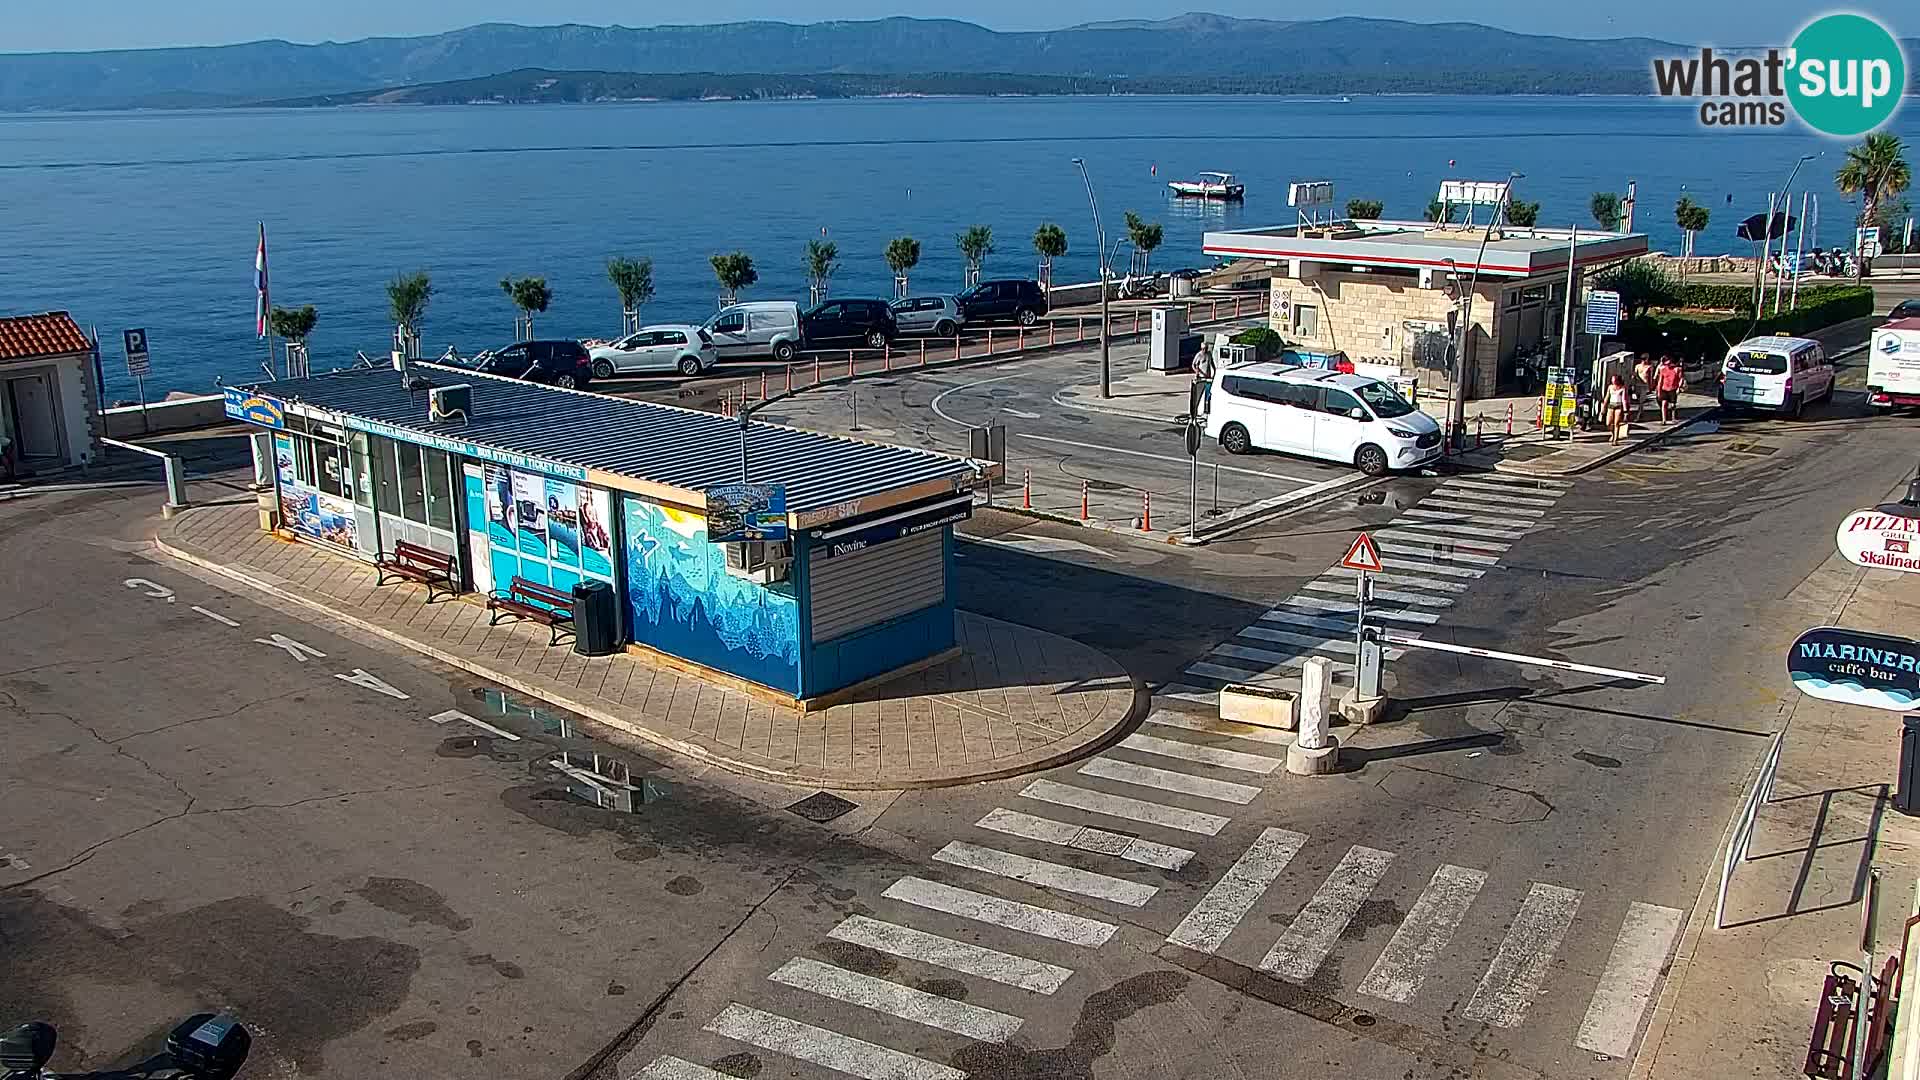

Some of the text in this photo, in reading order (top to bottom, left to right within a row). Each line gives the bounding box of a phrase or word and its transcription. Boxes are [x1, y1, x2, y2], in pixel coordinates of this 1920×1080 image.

[128, 332, 142, 351] P
[435, 437, 468, 452] POSTAJA
[477, 447, 582, 478] BUS STATION TICKET OFFICE
[1881, 531, 1917, 541] GRILL
[1828, 662, 1897, 681] caffe bar
